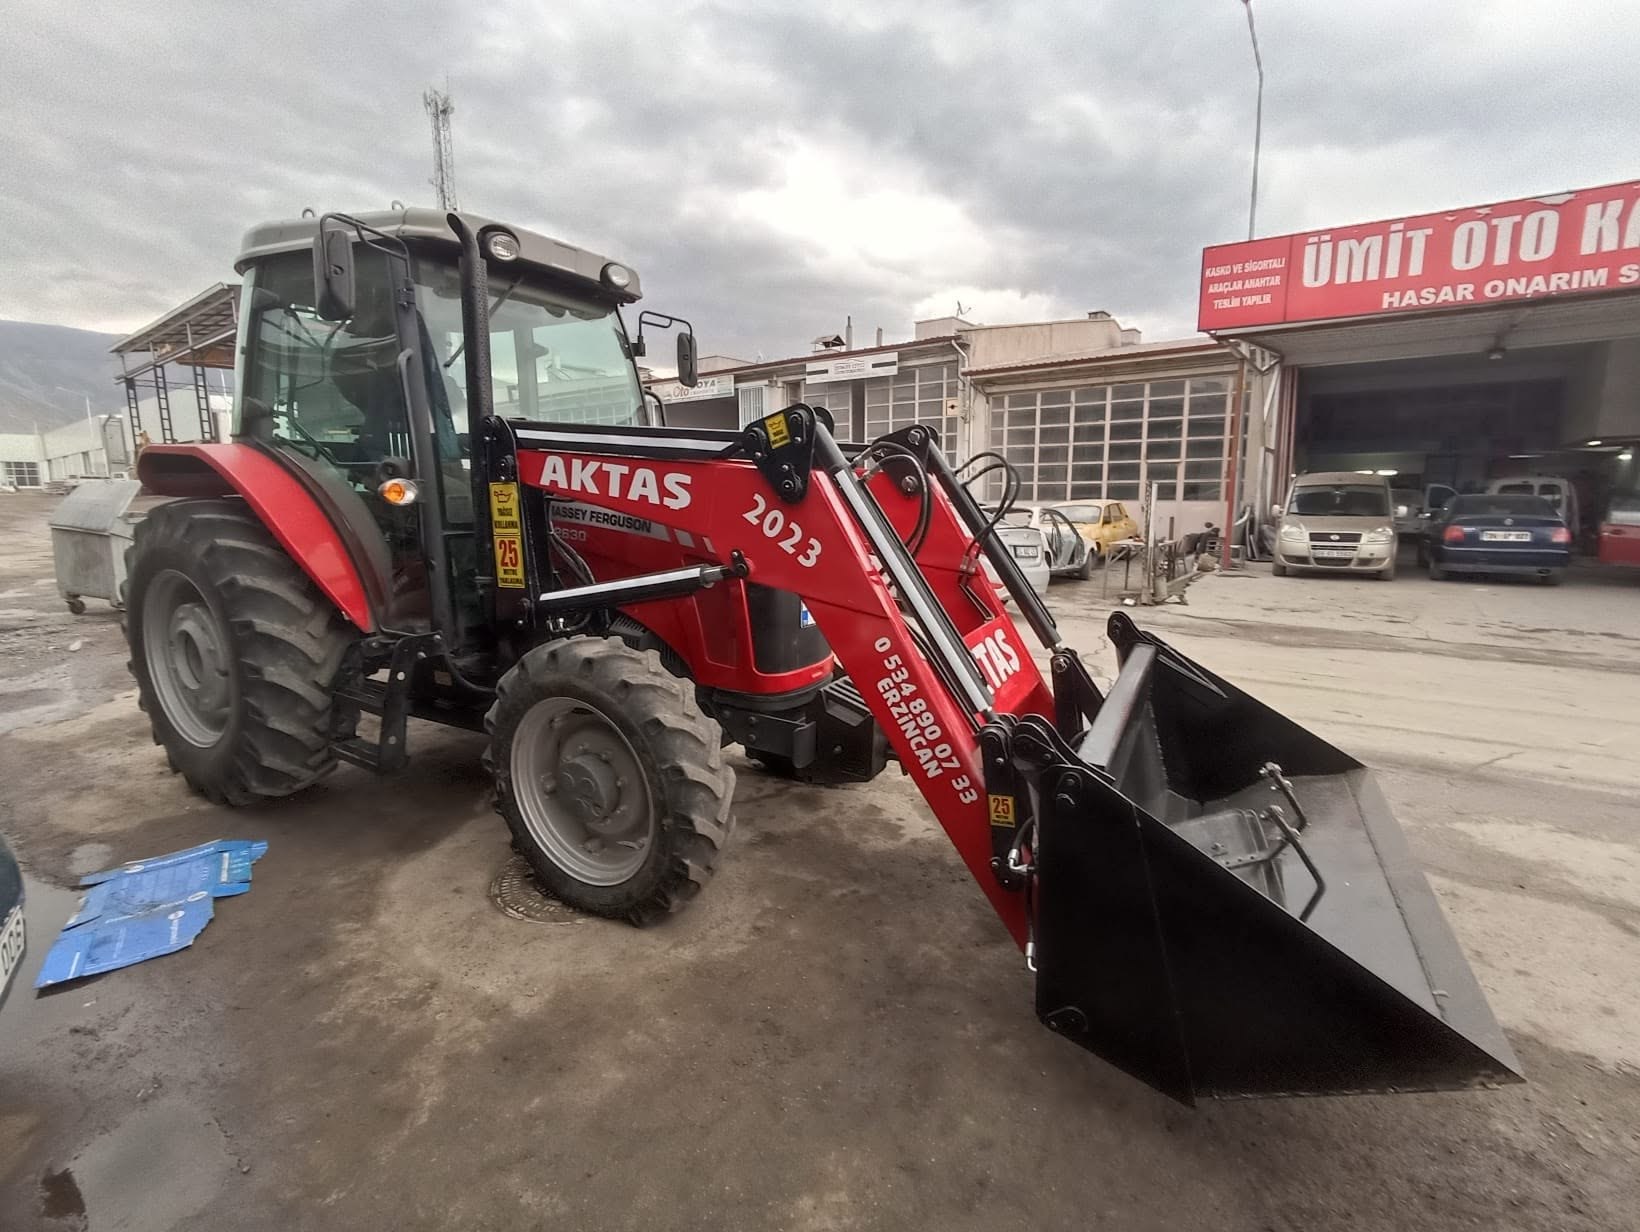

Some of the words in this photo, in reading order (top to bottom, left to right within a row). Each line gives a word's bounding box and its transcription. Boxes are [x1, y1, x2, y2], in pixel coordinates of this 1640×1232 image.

[1302, 222, 1434, 288] ÜMİT
[1451, 209, 1560, 271] OTO
[1233, 263, 1243, 274] VE
[1382, 282, 1475, 309] HASAR
[1484, 267, 1609, 297] ONARIM
[589, 510, 652, 533] FERGUSON
[742, 493, 822, 568] 2023
[498, 539, 519, 568] 25
[874, 637, 892, 653] 0
[883, 654, 918, 697] 534
[908, 698, 942, 741] 890
[934, 743, 961, 769] 07
[951, 775, 978, 804] 33
[993, 797, 1010, 815] 25
